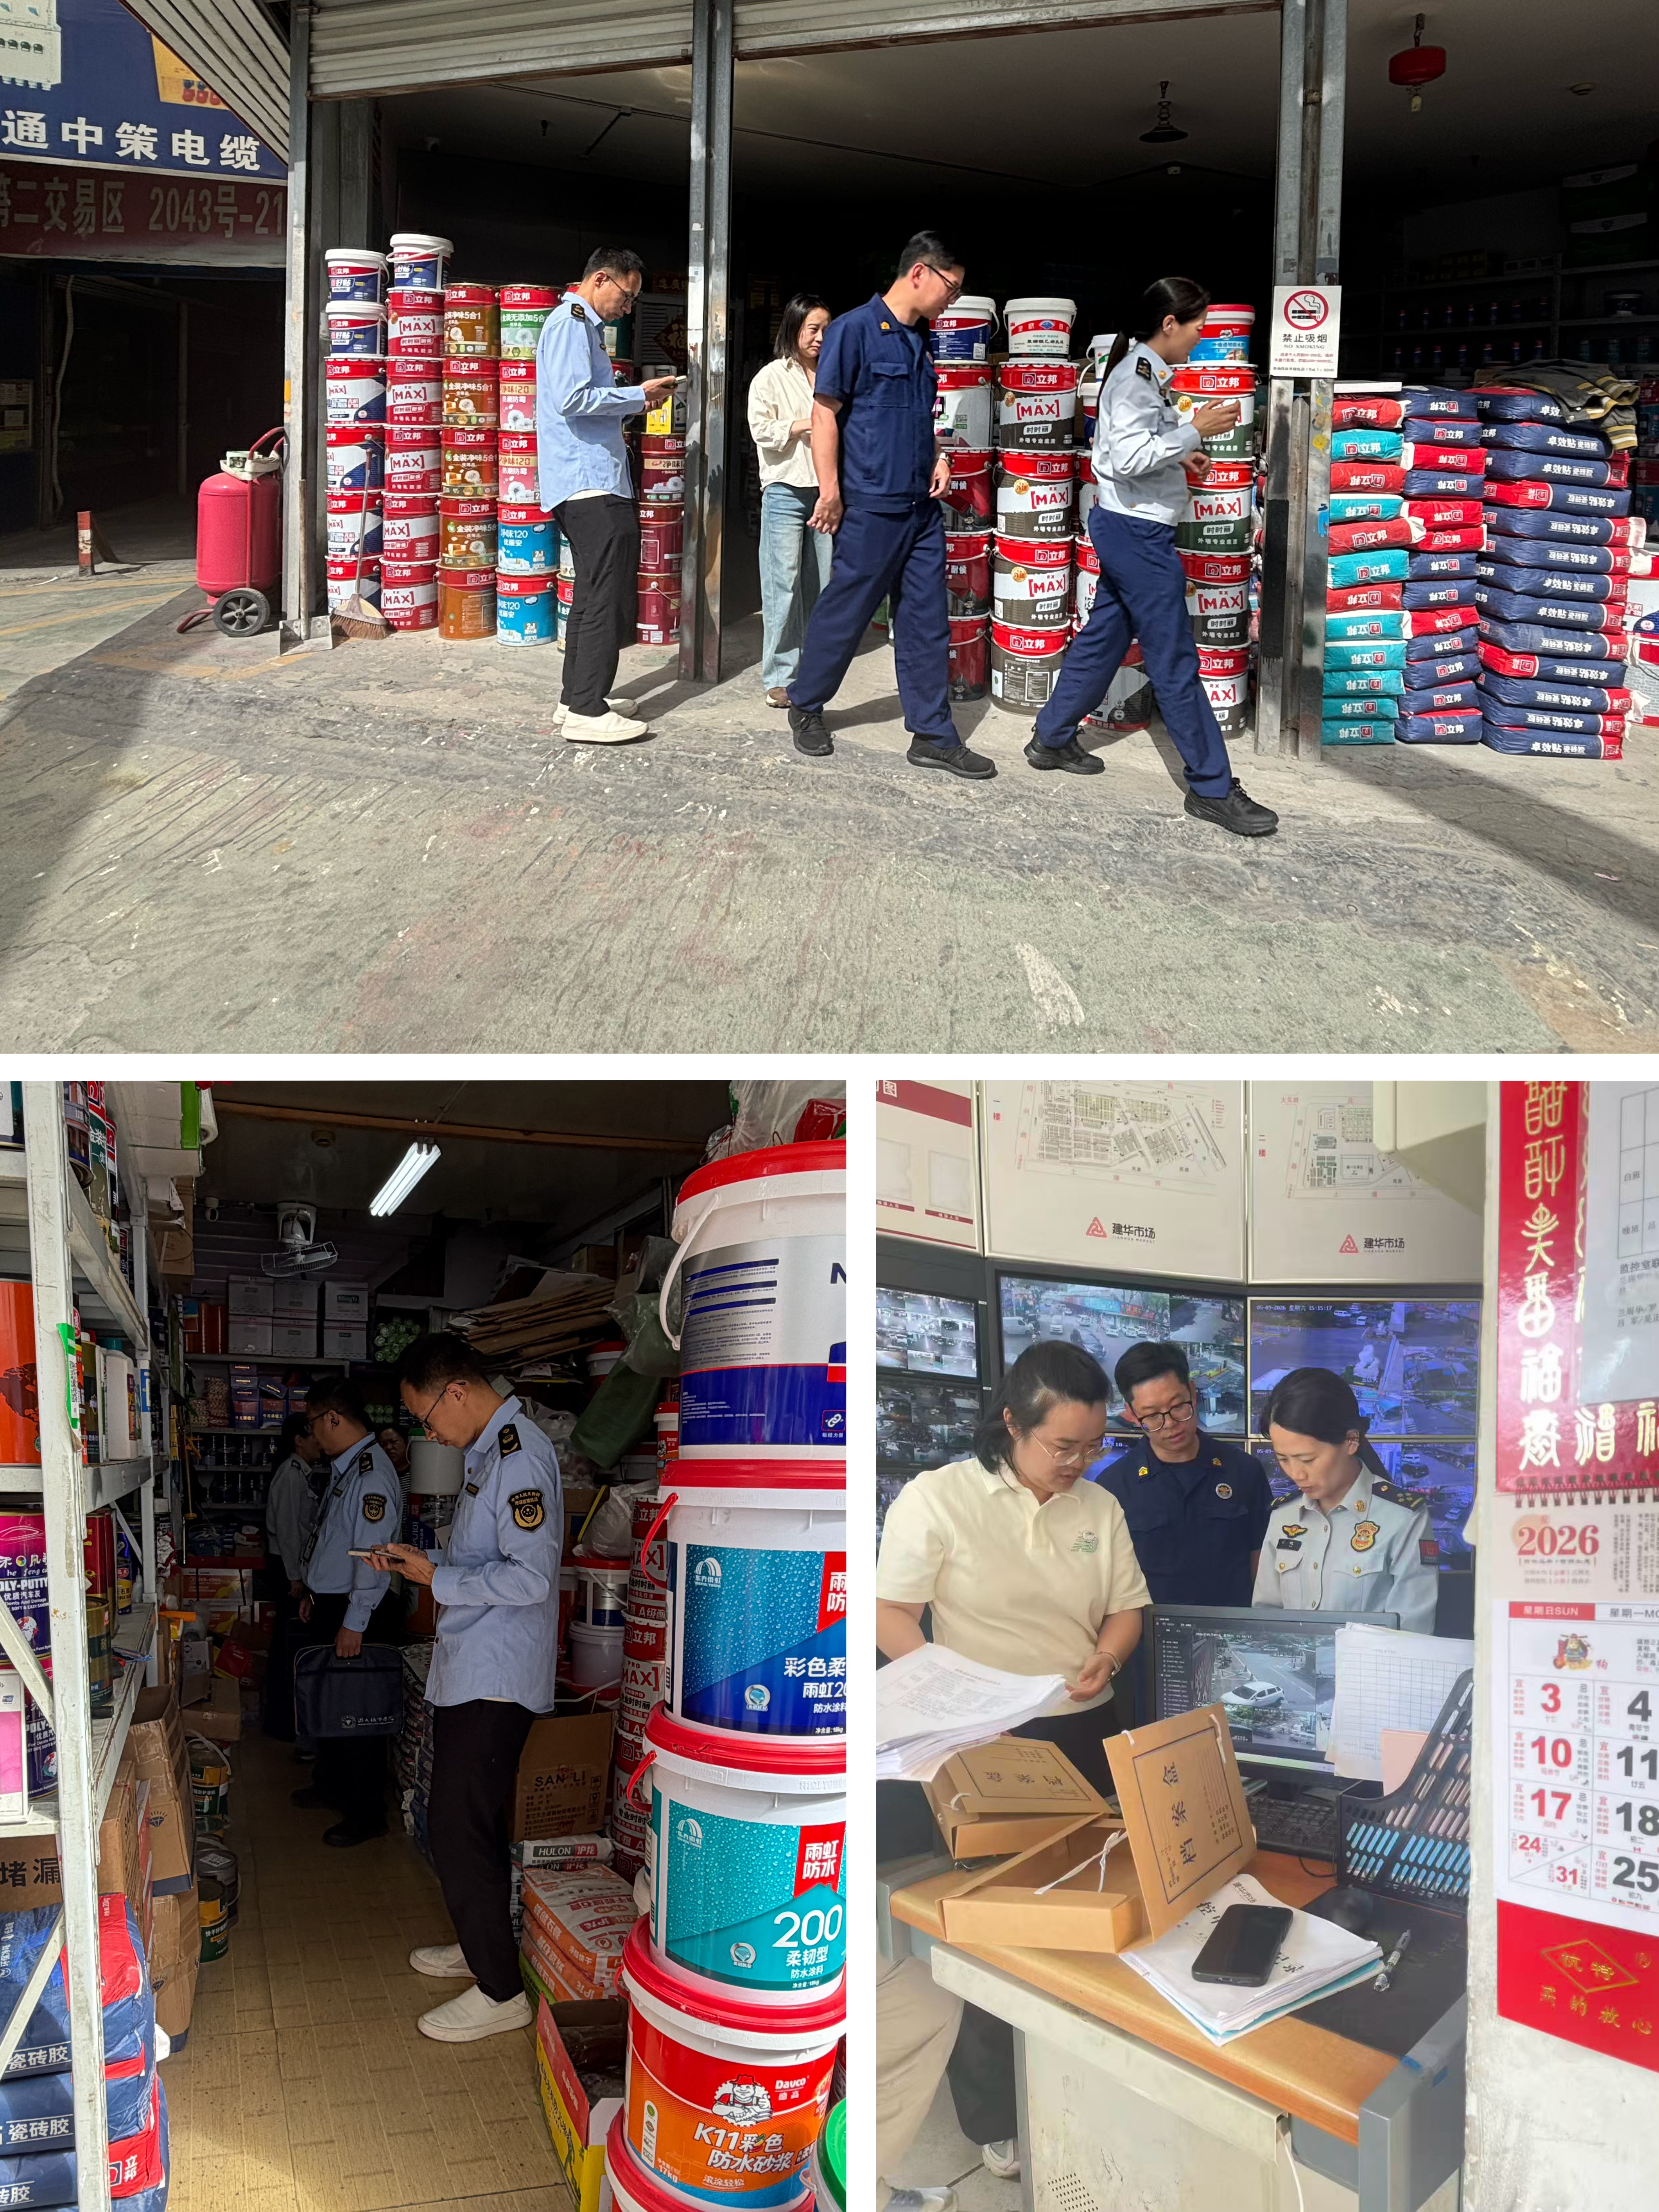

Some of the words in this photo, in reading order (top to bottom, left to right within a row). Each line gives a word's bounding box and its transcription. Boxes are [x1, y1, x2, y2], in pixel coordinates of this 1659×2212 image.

[1, 110, 260, 170] 通中策电缆
[1282, 333, 1327, 342] 禁止吸烟
[1217, 378, 1239, 388] 立邦
[1357, 409, 1377, 419] 立邦
[1052, 464, 1068, 472] 立邦
[1217, 472, 1239, 481] 立邦
[1351, 476, 1371, 486] 立邦
[1345, 507, 1368, 517] 立邦
[1049, 551, 1065, 560] 立邦
[1212, 659, 1233, 669] 立邦
[1112, 1223, 1156, 1239] 建华市场
[1363, 1237, 1405, 1249] 建华市场
[1517, 1525, 1600, 1556] 2026
[4, 1590, 40, 1601] 优质汽车灰
[784, 1656, 846, 1678] 彩色柔
[1541, 1682, 1561, 1713] 3
[1627, 1690, 1652, 1722] 4
[1531, 1735, 1572, 1768] 10
[1617, 1746, 1658, 1780] 11
[535, 1773, 565, 1787] SAN
[573, 1771, 585, 1782] LI
[1162, 1760, 1197, 1866] 档案盒
[1531, 1788, 1572, 1820] 17
[1615, 1802, 1659, 1836] 18
[538, 1847, 571, 1856] HULON
[577, 1846, 595, 1855] 沪龙
[805, 1839, 839, 1861] 雨虹
[802, 1859, 835, 1880] 防水
[1518, 1834, 1541, 1853] 24
[1556, 1866, 1578, 1886] 31
[1612, 1856, 1659, 1893] 25
[772, 1904, 843, 1948] 200
[786, 1945, 829, 1967] 柔韧型
[791, 1965, 823, 1979] 防水涂料
[8, 2045, 69, 2072] 瓷砖胶
[775, 2078, 806, 2090] Dauco
[8, 2117, 70, 2141] 瓷砖胶
[124, 2155, 138, 2181] 立邦
[708, 2150, 794, 2174] 防水砂浆
[703, 2175, 744, 2187] 滚涂轻松
